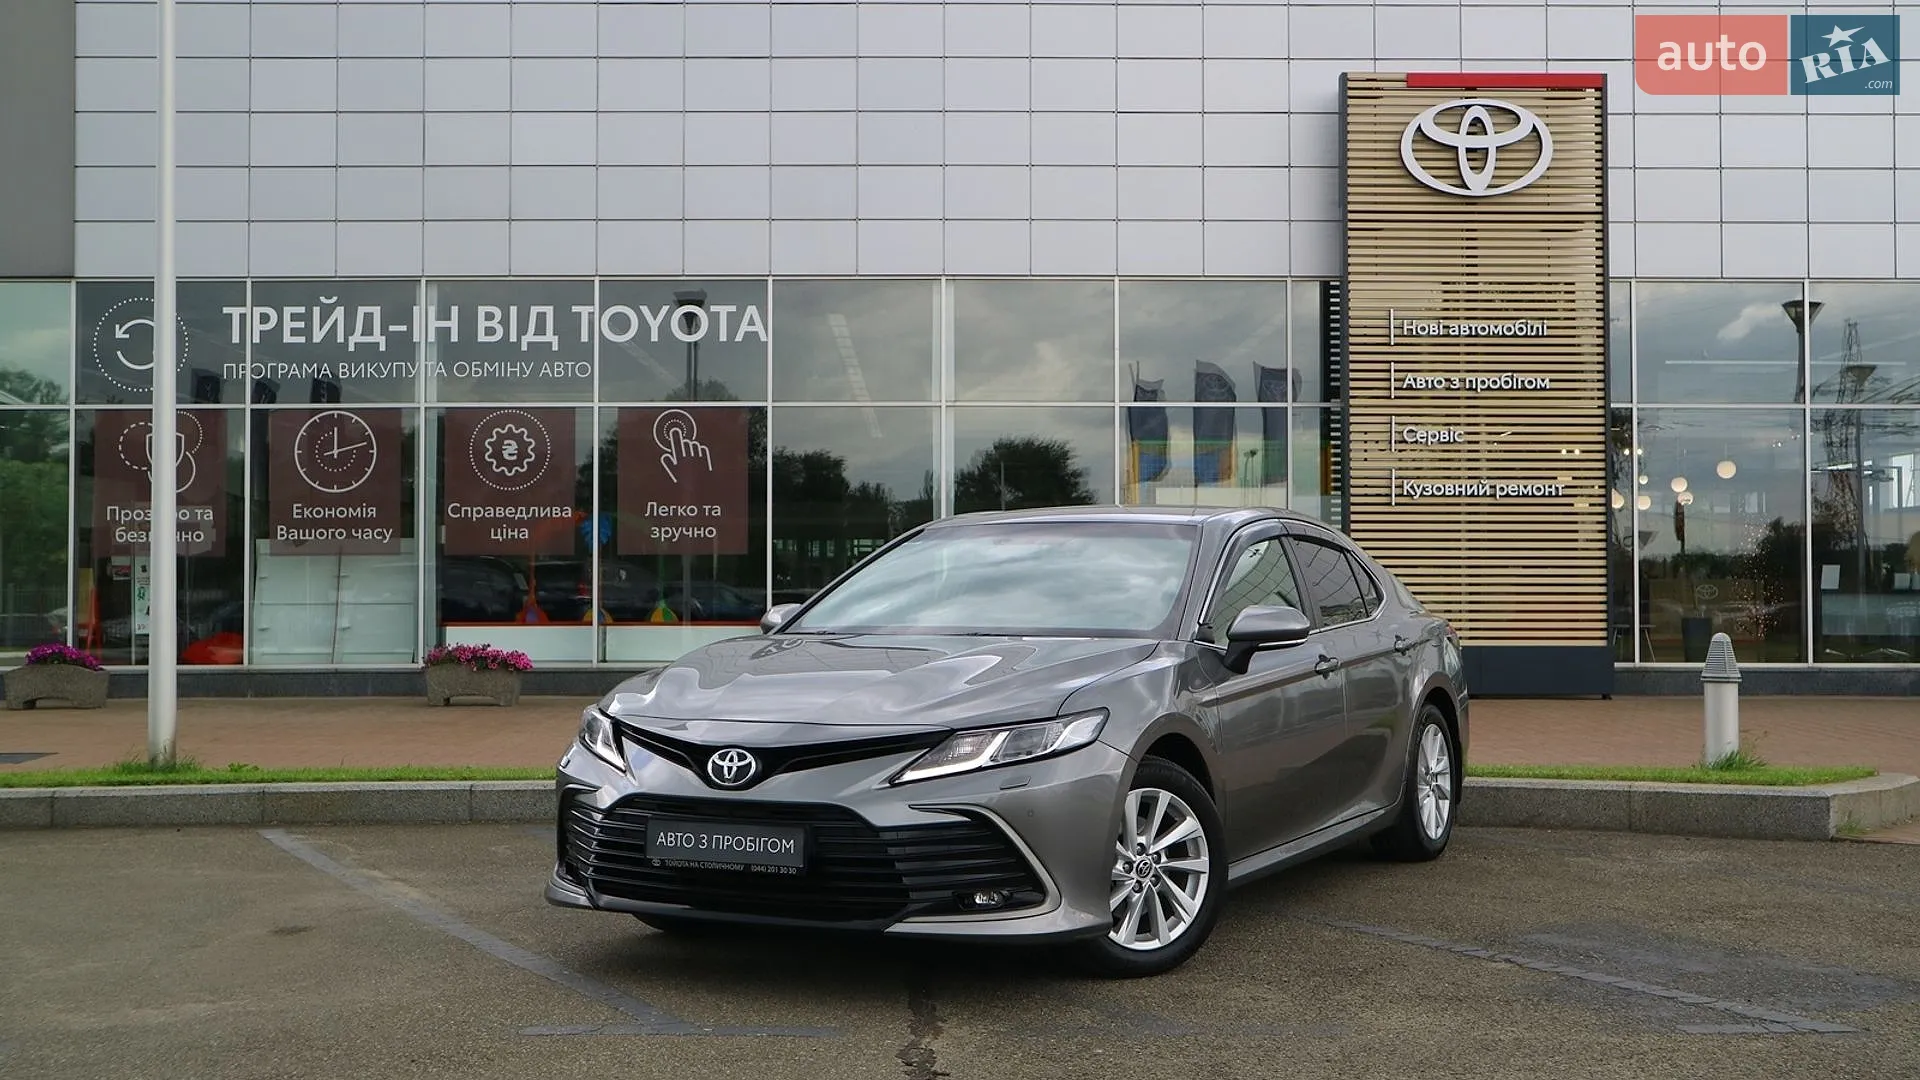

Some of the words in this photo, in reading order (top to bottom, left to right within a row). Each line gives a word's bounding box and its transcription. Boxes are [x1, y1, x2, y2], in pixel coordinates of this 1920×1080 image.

[222, 296, 459, 352] ТРЕЙД-ІН
[477, 305, 559, 351] ВІД
[571, 304, 769, 343] TOYOTA
[1403, 320, 1444, 335] Нові
[1449, 320, 1548, 336] автомобілі
[223, 363, 333, 380] ПРОГРАМА
[339, 362, 419, 379] ВИКУПУ
[424, 361, 447, 377] ТА
[453, 361, 534, 378] ОБМІНУ
[539, 361, 592, 378] АВТО
[1403, 373, 1446, 389] Авто
[1450, 377, 1460, 389] з
[1465, 373, 1550, 393] пробігом
[1403, 426, 1465, 446] Сервіс
[1403, 480, 1491, 500] Кузовний
[1496, 484, 1565, 500] ремонт
[106, 506, 189, 524] Прозо
[194, 509, 213, 520] та
[292, 503, 376, 519] Економія
[447, 503, 572, 521] Справедлива
[645, 502, 698, 517] Легко
[703, 505, 721, 517] та
[115, 527, 204, 542] безно
[277, 525, 345, 540] Вашого
[351, 527, 393, 543] часу
[490, 524, 529, 542] ціна
[650, 525, 717, 542] зручно
[656, 832, 695, 848] АВТО
[698, 834, 708, 849] З
[712, 835, 795, 854] ПРОБІГОМ
